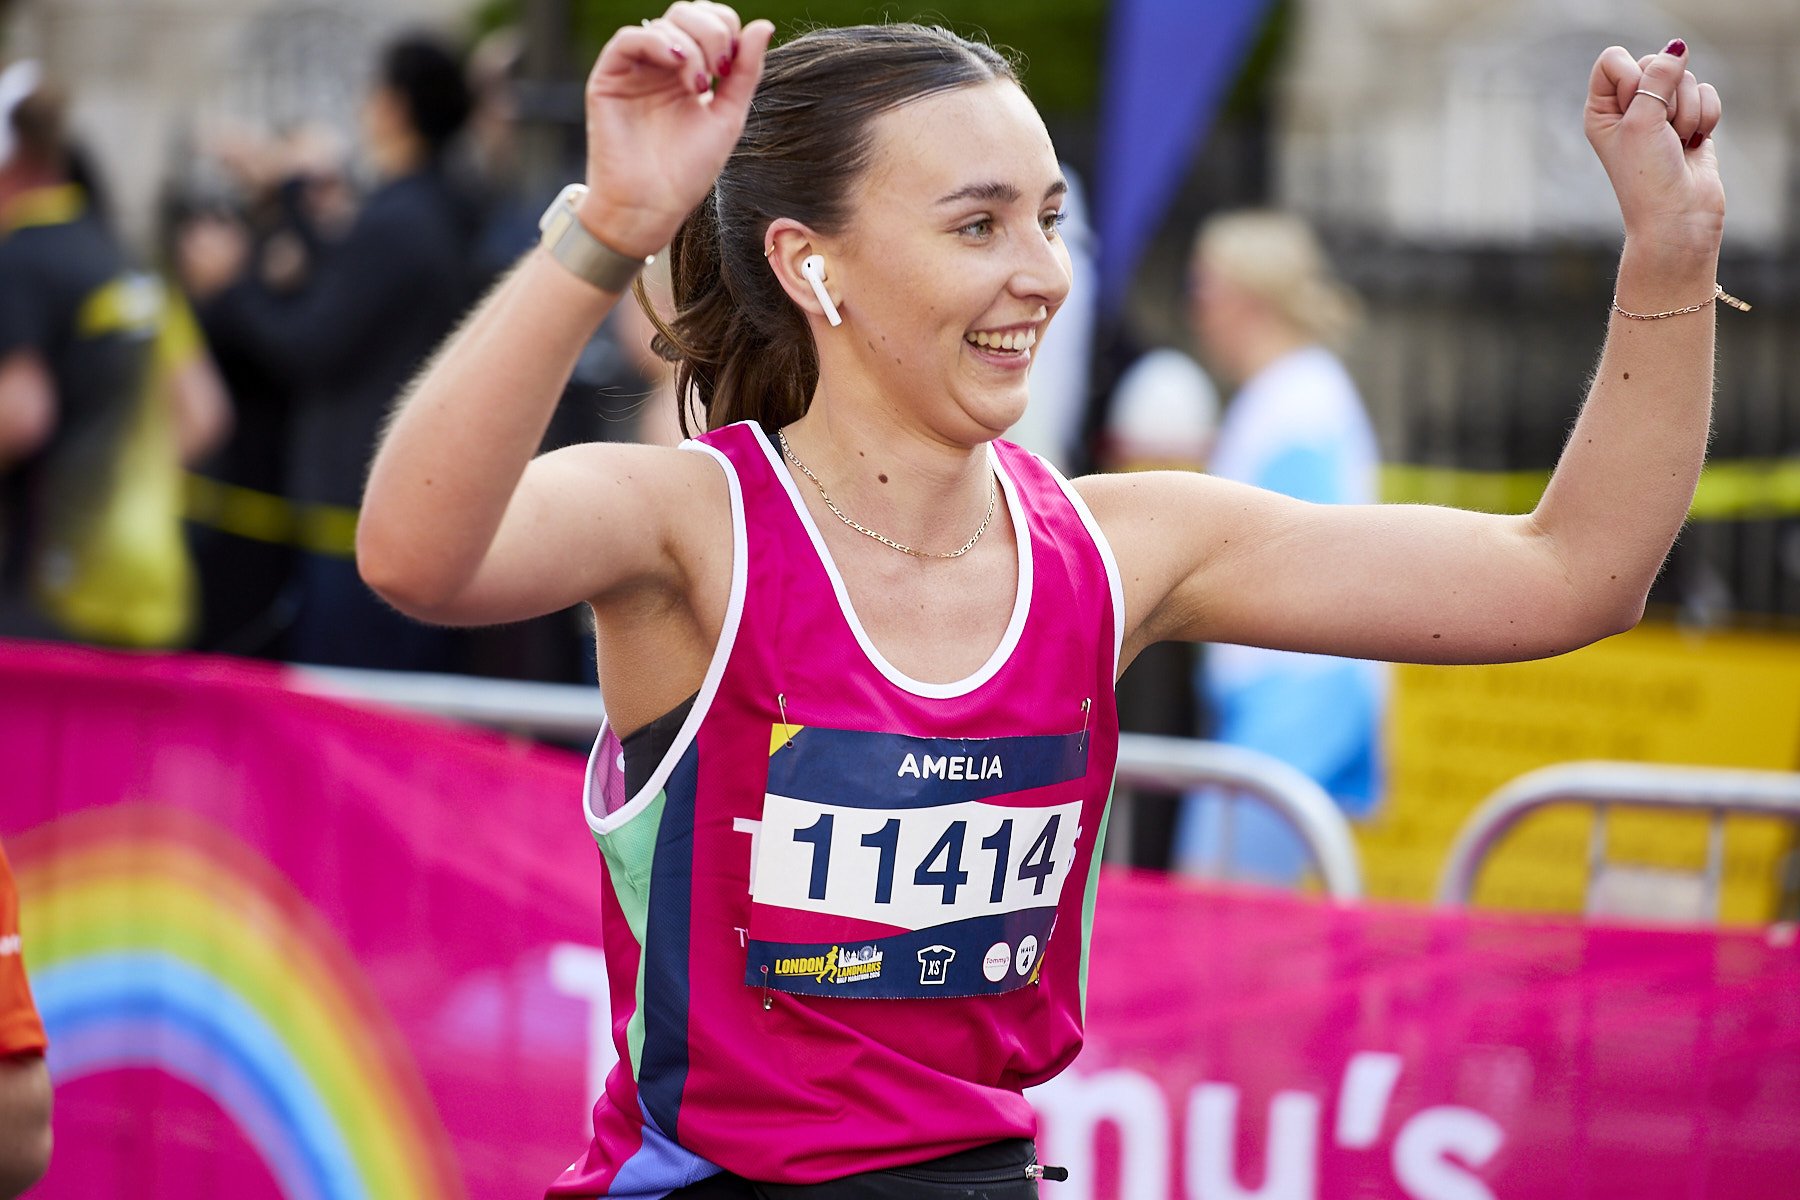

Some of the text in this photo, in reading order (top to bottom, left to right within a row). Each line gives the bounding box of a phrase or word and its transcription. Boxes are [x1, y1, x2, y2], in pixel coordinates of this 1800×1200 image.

[898, 753, 1003, 780] AMELIA
[793, 813, 1062, 905] 11414
[1020, 944, 1035, 954] WAVE
[775, 956, 825, 975] LONDON
[837, 961, 881, 978] LANDMARKS
[928, 960, 941, 976] XS
[1022, 954, 1029, 968] 4
